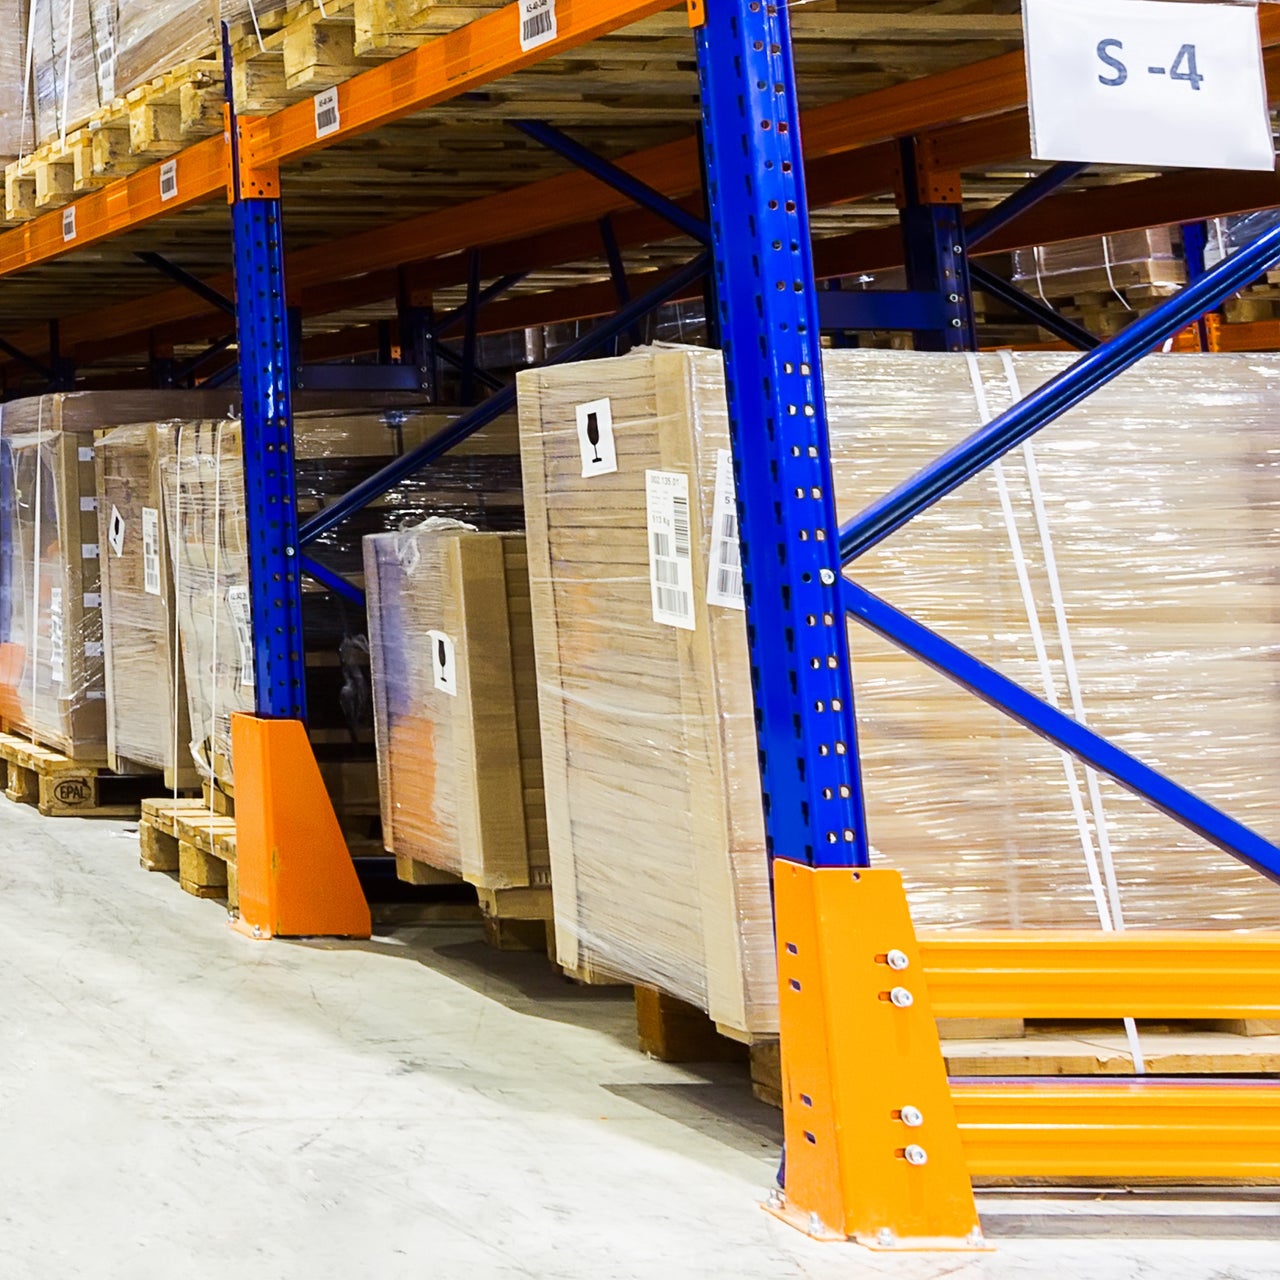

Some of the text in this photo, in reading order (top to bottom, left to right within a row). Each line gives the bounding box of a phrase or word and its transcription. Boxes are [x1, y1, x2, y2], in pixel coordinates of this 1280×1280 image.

[1096, 38, 1204, 91] S -4
[60, 785, 86, 800] EPAL
